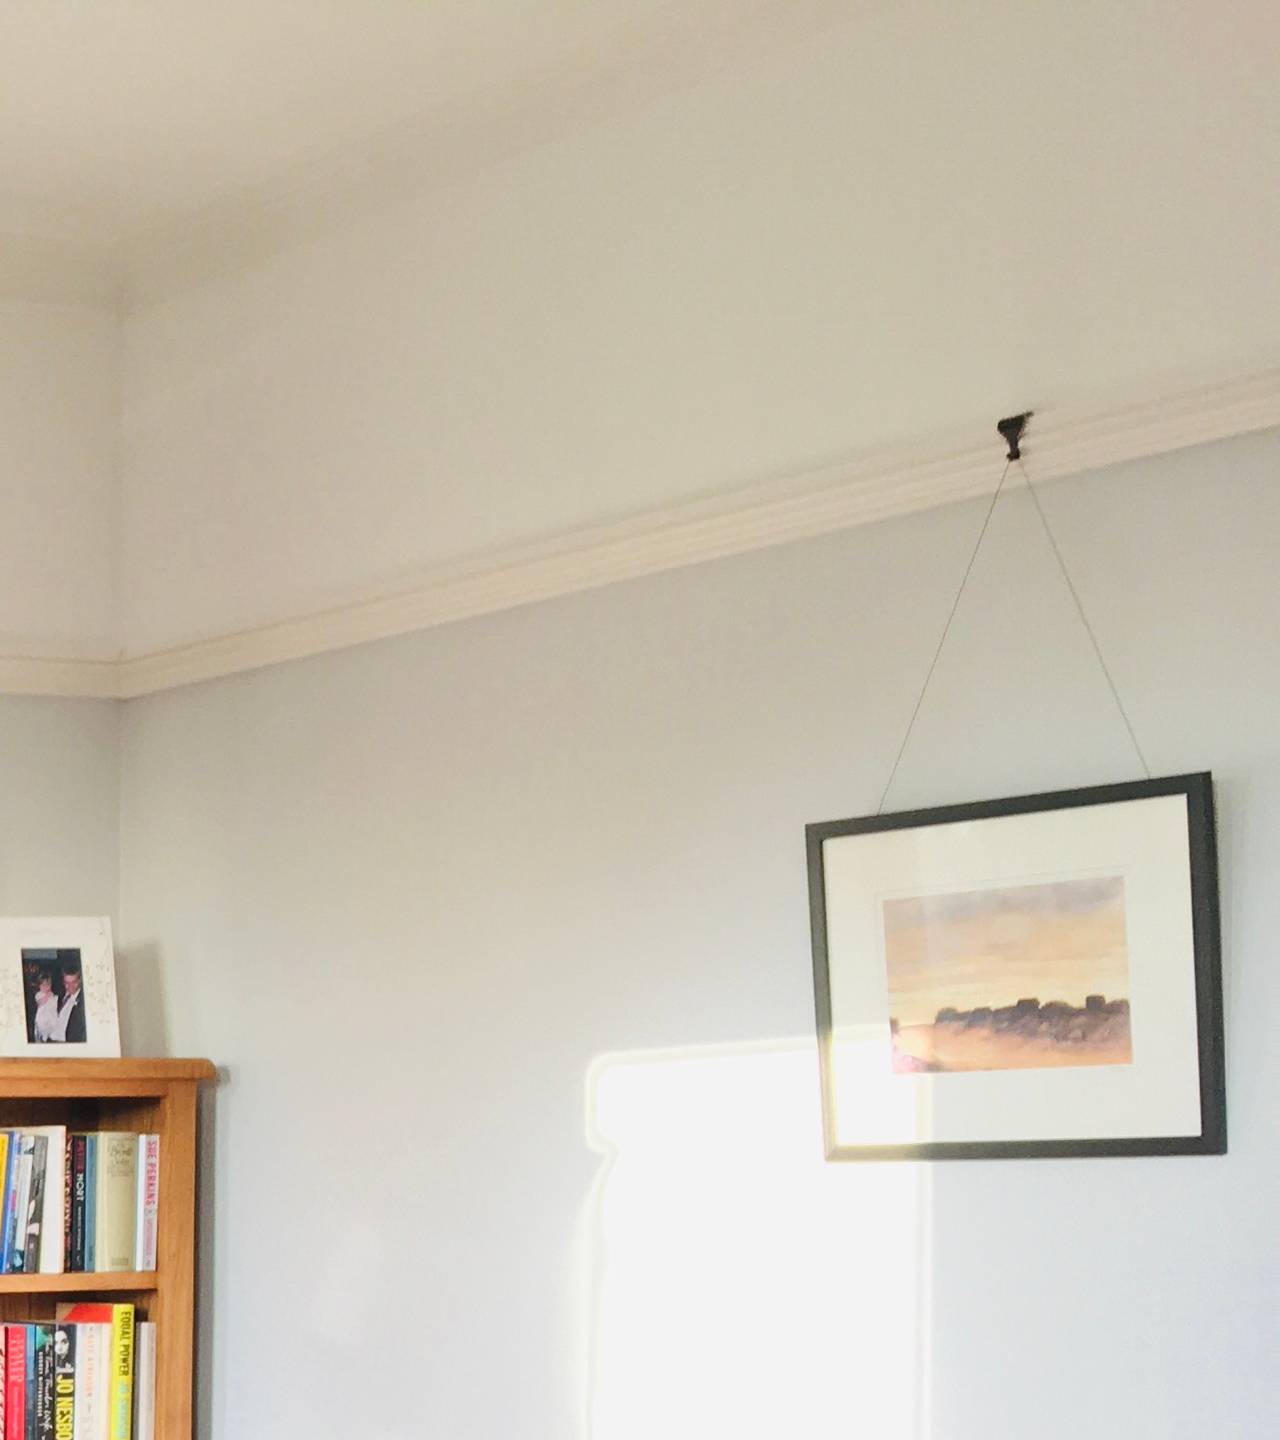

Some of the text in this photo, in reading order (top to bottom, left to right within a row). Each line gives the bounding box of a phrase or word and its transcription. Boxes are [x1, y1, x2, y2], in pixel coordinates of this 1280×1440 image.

[145, 1162, 157, 1206] PERKINS
[118, 1311, 132, 1377] EQUAL POWER
[55, 1374, 74, 1394] JO
